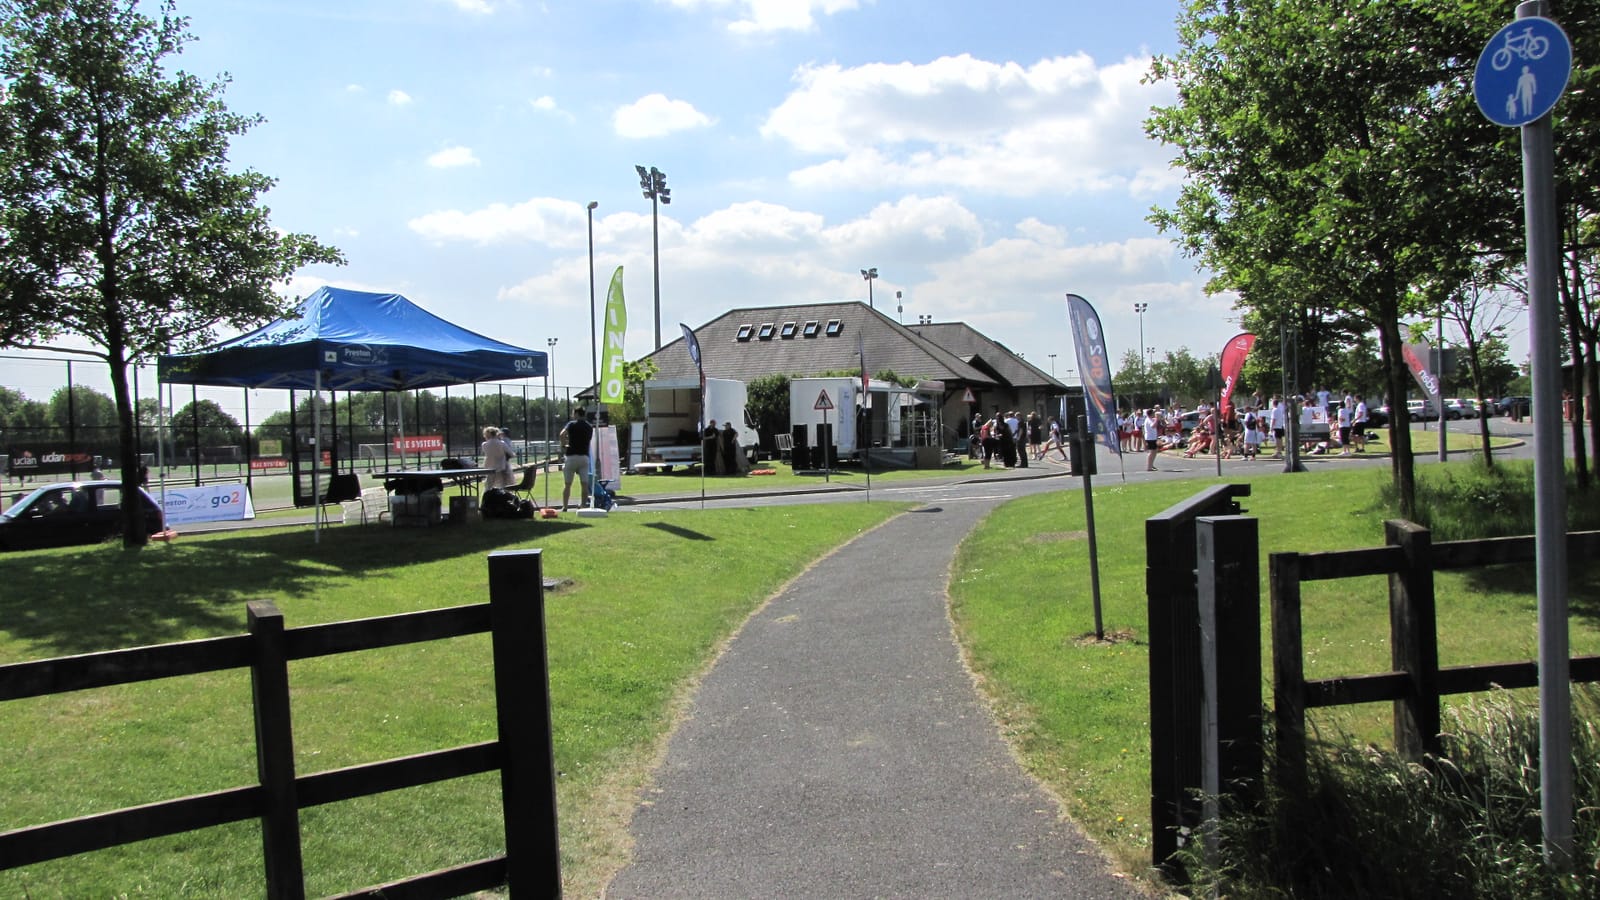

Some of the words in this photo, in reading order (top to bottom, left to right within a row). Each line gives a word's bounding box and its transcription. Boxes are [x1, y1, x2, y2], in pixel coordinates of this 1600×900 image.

[606, 308, 624, 398] INFO
[514, 357, 533, 371] go2
[411, 439, 441, 449] SYSTEMS
[211, 490, 240, 508] go2
